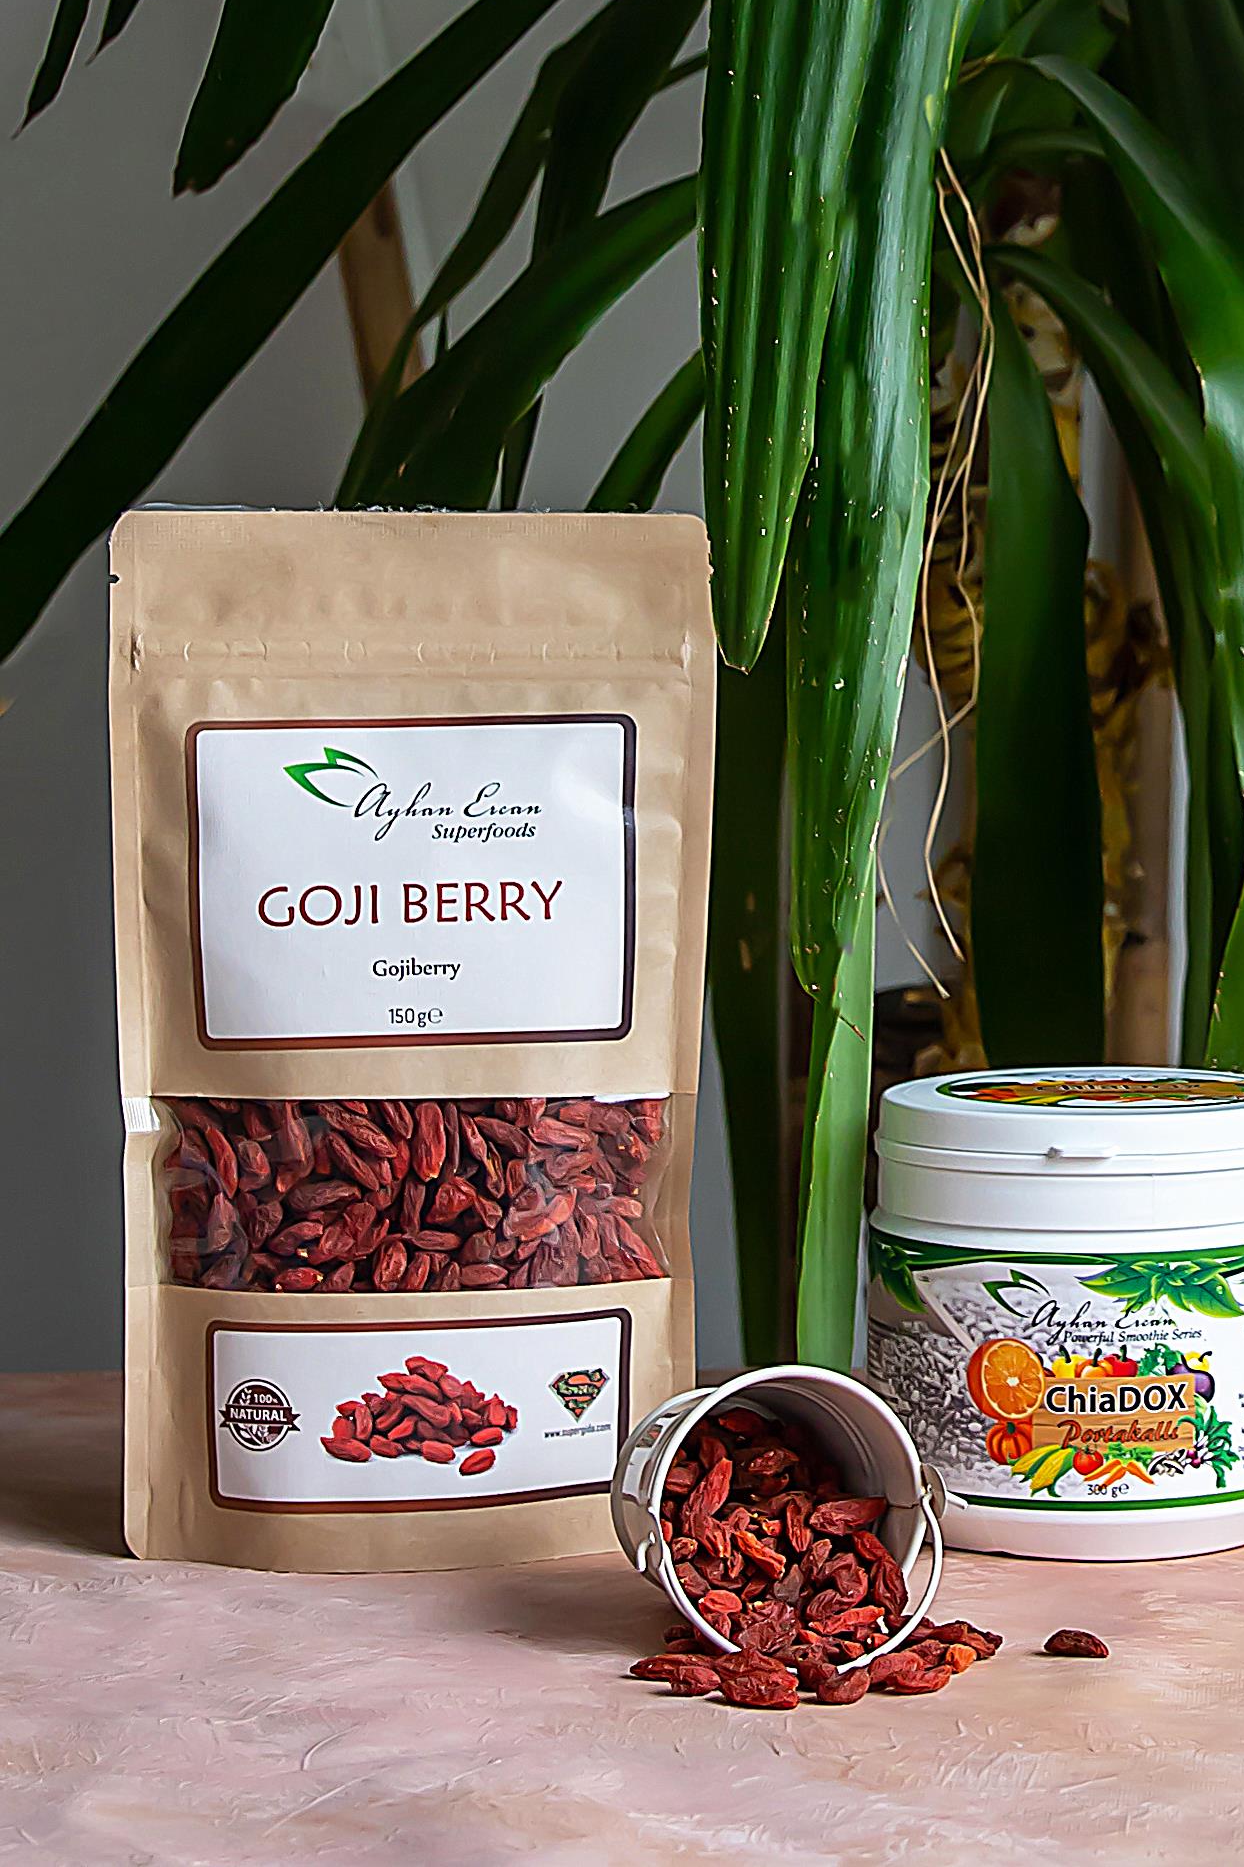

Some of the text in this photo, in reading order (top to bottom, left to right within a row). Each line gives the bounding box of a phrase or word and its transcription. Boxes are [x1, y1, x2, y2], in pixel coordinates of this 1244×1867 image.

[354, 782, 454, 841] Ayhan
[431, 822, 537, 843] Superfoods
[258, 880, 563, 928] GOJI BERRY
[372, 957, 461, 981] Gojiberry
[1031, 1300, 1108, 1346] Ayhan
[1063, 1329, 1202, 1346] Powerful Smoothie Series
[1045, 1383, 1187, 1413] ChiaDOX
[230, 1407, 287, 1422] NATURAL
